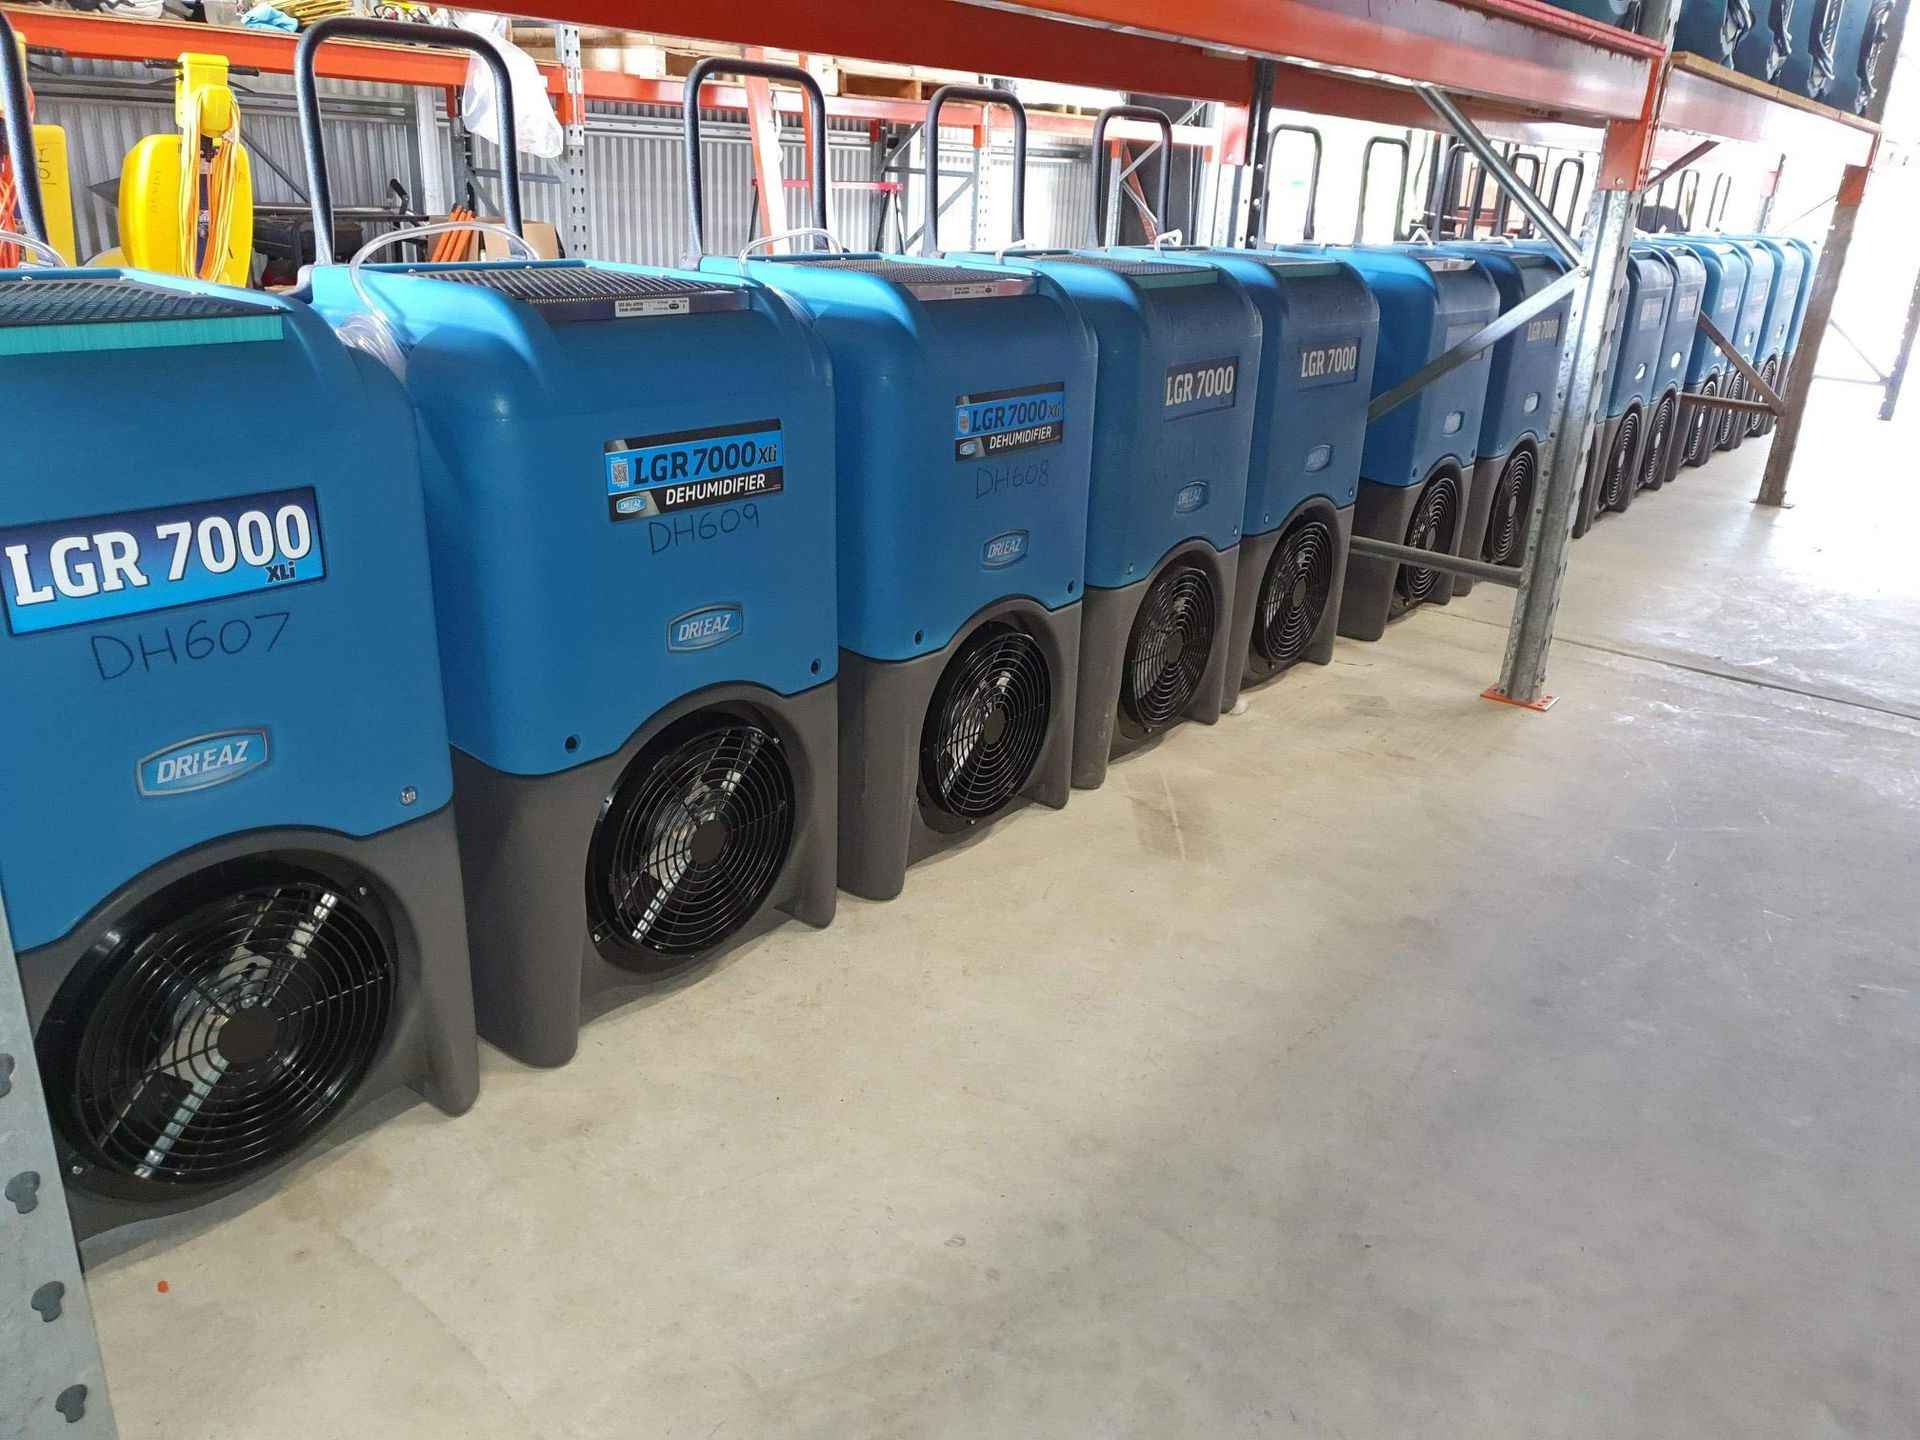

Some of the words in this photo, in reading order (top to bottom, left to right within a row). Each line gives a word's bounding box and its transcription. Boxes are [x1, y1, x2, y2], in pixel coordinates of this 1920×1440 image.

[1300, 350, 1325, 378] LGR
[1327, 345, 1357, 374] 7000
[1165, 373, 1193, 406] LGR
[1196, 365, 1234, 400] 7000
[971, 405, 1006, 432] LGR
[1007, 399, 1047, 427] 7000
[989, 425, 1052, 450] DEHUMIDIFIER
[634, 451, 689, 485] LGR
[692, 440, 756, 476] 7000
[976, 460, 1050, 500] DH608
[665, 473, 766, 506] DEHUMIDIFIER
[649, 502, 760, 555] DH609
[5, 530, 148, 605] LGR
[155, 504, 312, 582] 7000
[91, 611, 290, 680] DH607
